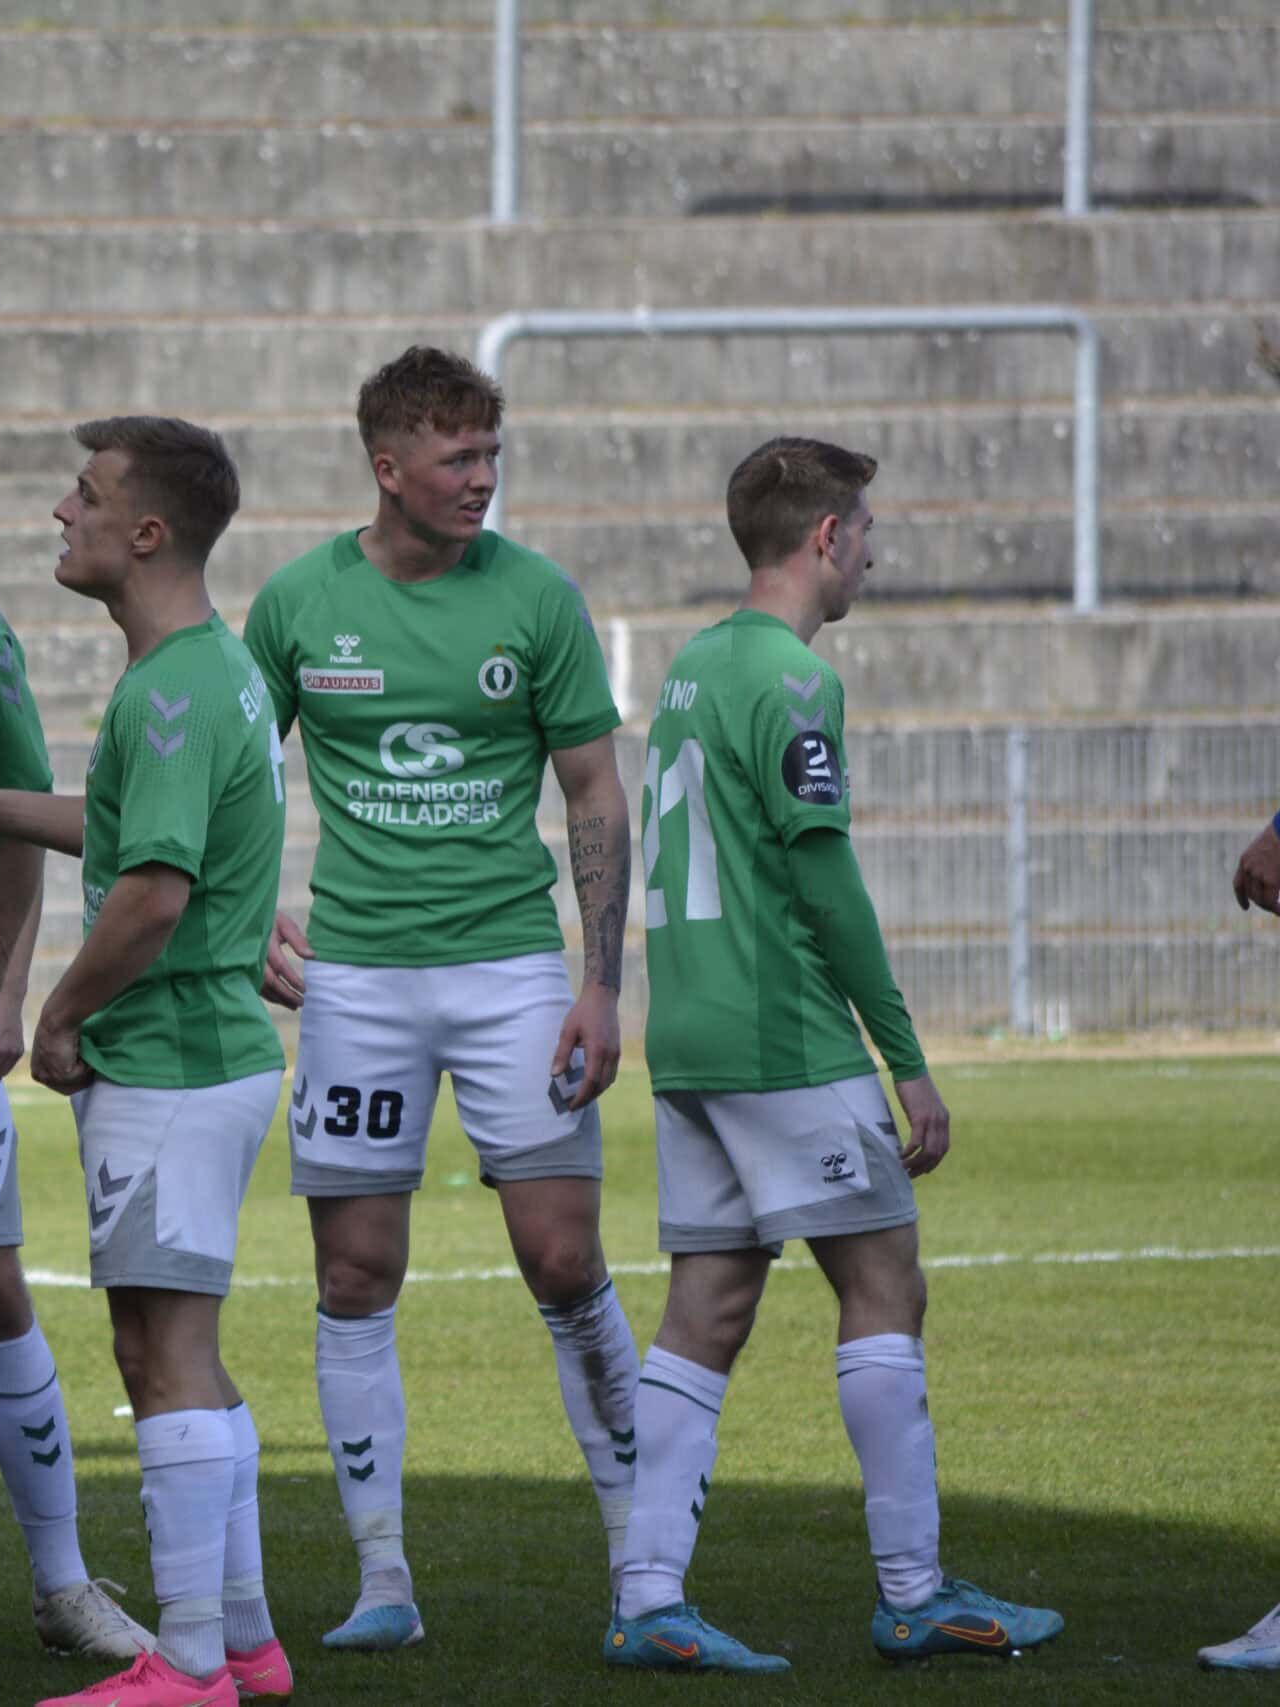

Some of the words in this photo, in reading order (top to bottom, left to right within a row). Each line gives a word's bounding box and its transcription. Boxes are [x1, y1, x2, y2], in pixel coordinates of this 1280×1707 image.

[313, 677, 380, 690] BAUHAUS
[346, 779, 504, 802] OLDENBORG
[347, 801, 502, 826] STILLADSER
[323, 1084, 404, 1140] 30
